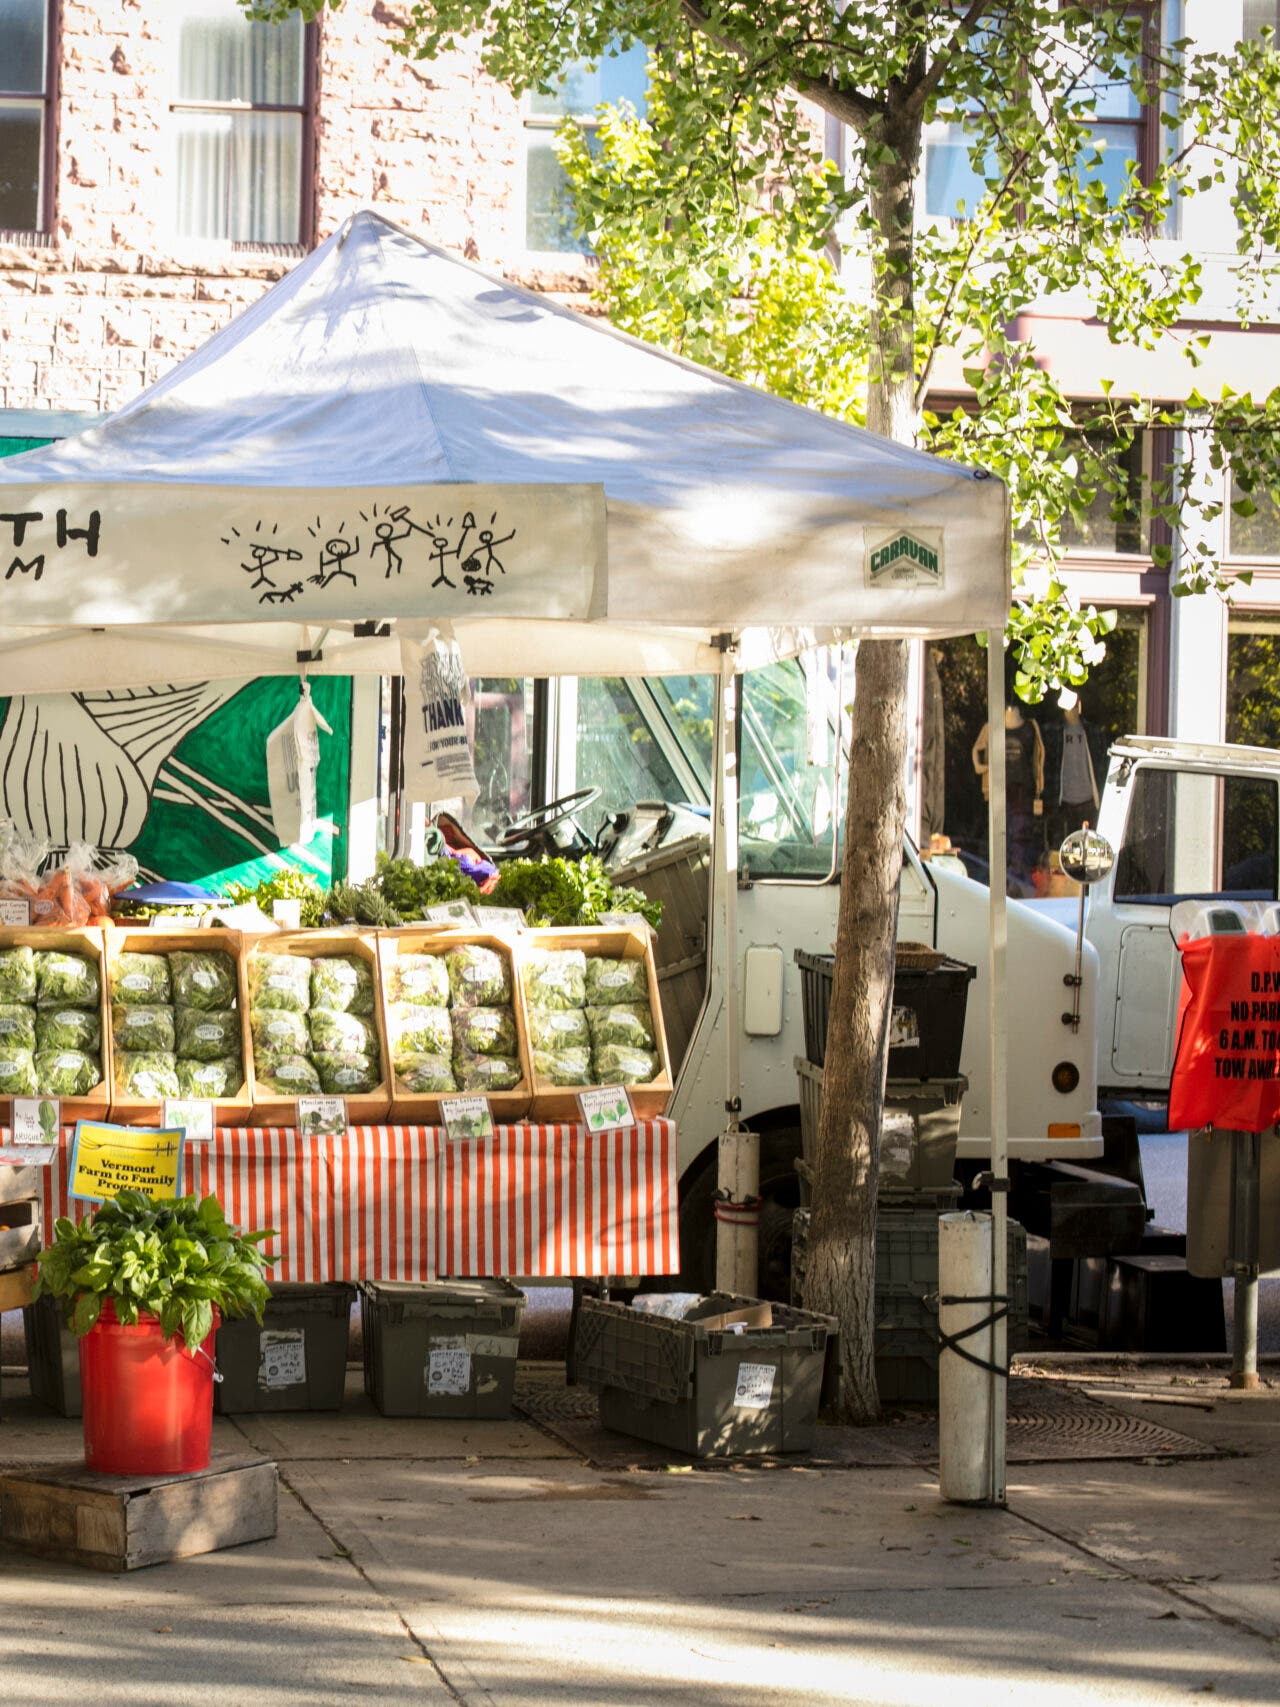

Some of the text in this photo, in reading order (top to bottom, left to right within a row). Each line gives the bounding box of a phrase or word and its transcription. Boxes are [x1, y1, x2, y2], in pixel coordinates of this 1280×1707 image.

[870, 535, 938, 574] CARAVAN
[422, 699, 465, 733] THANK
[1231, 1001, 1249, 1021] NO
[1220, 1029, 1228, 1049] 6
[1231, 1029, 1259, 1050] A.M.
[1215, 1058, 1246, 1079] TOW
[79, 1165, 175, 1187] Farm to Family
[101, 1160, 155, 1174] Vermont
